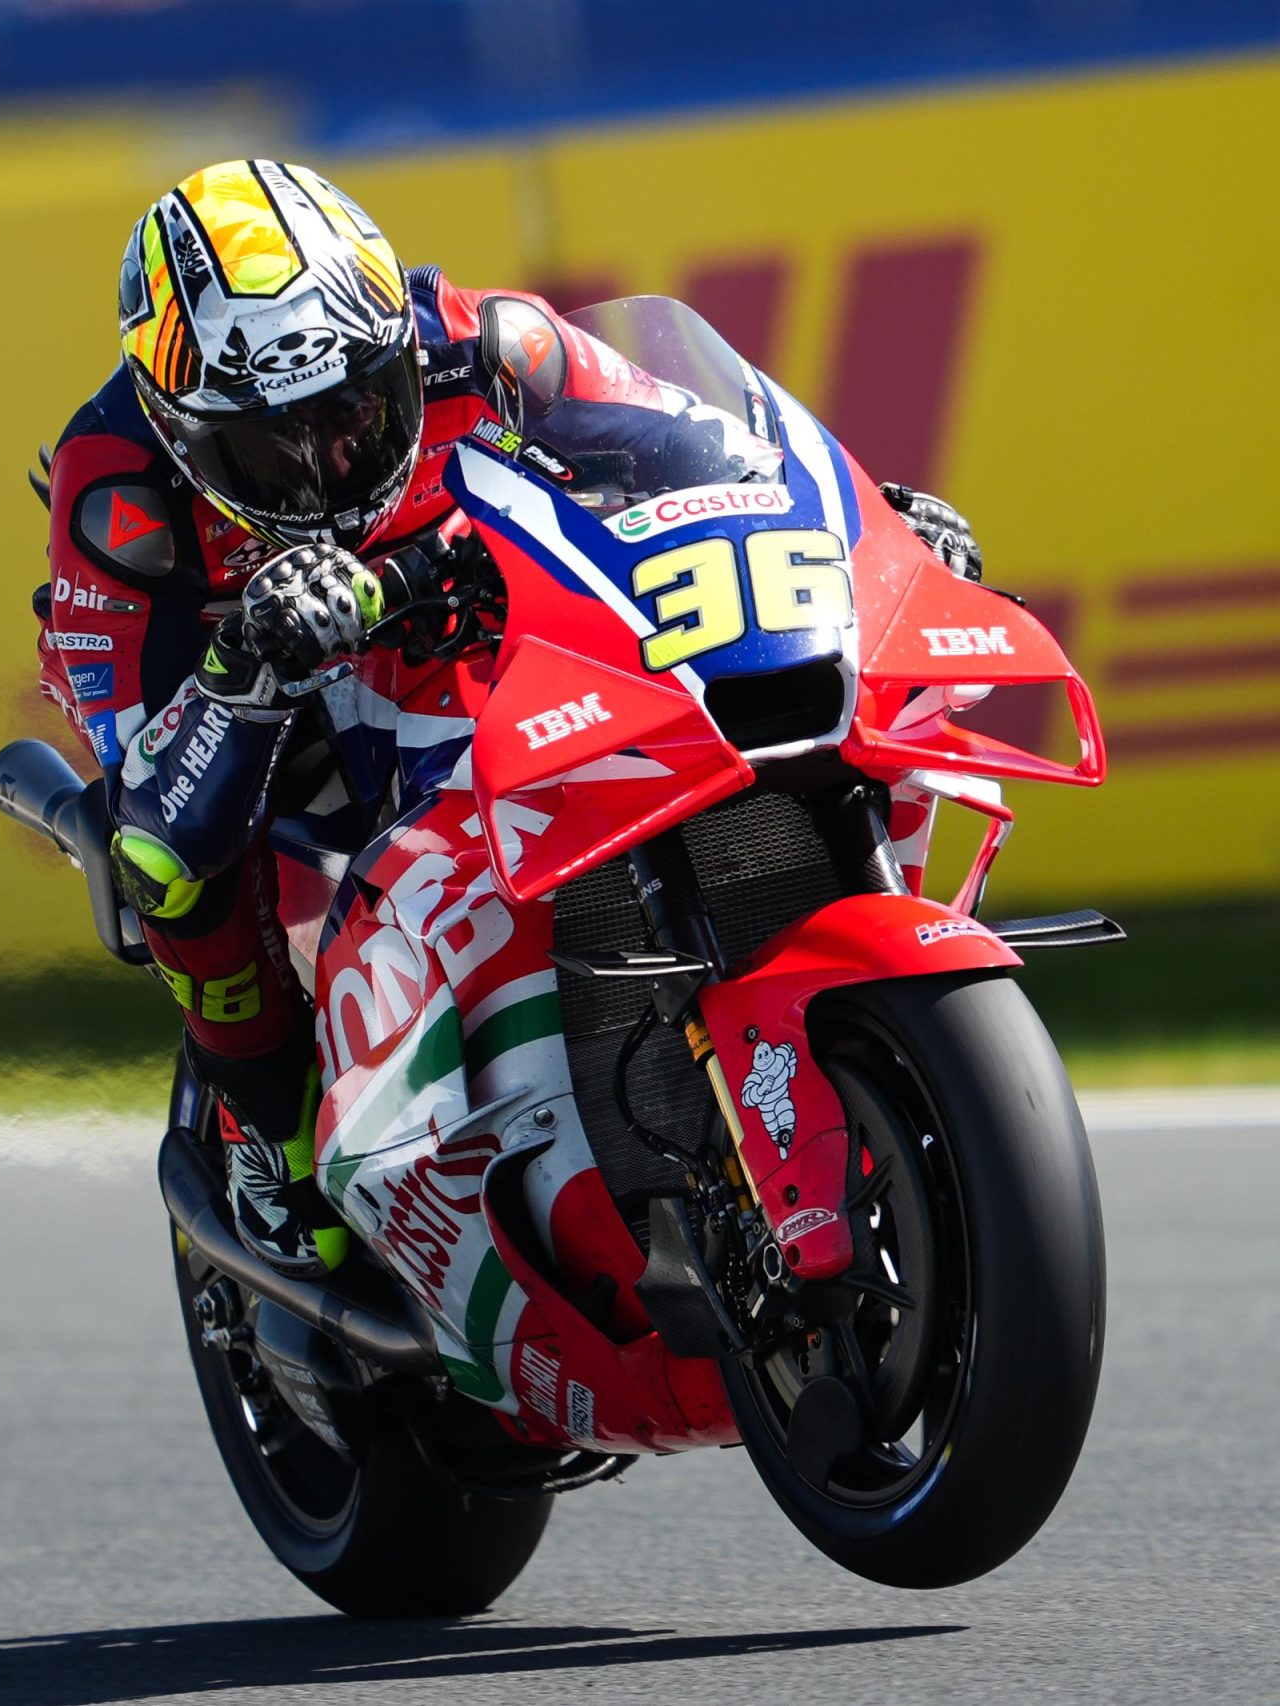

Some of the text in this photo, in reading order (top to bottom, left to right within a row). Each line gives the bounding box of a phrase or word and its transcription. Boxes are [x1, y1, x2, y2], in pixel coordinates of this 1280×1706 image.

[259, 356, 346, 393] Kabuto
[655, 489, 783, 526] Castrol
[630, 528, 854, 671] 36
[920, 626, 1014, 657] IBM
[516, 693, 612, 750] IBM
